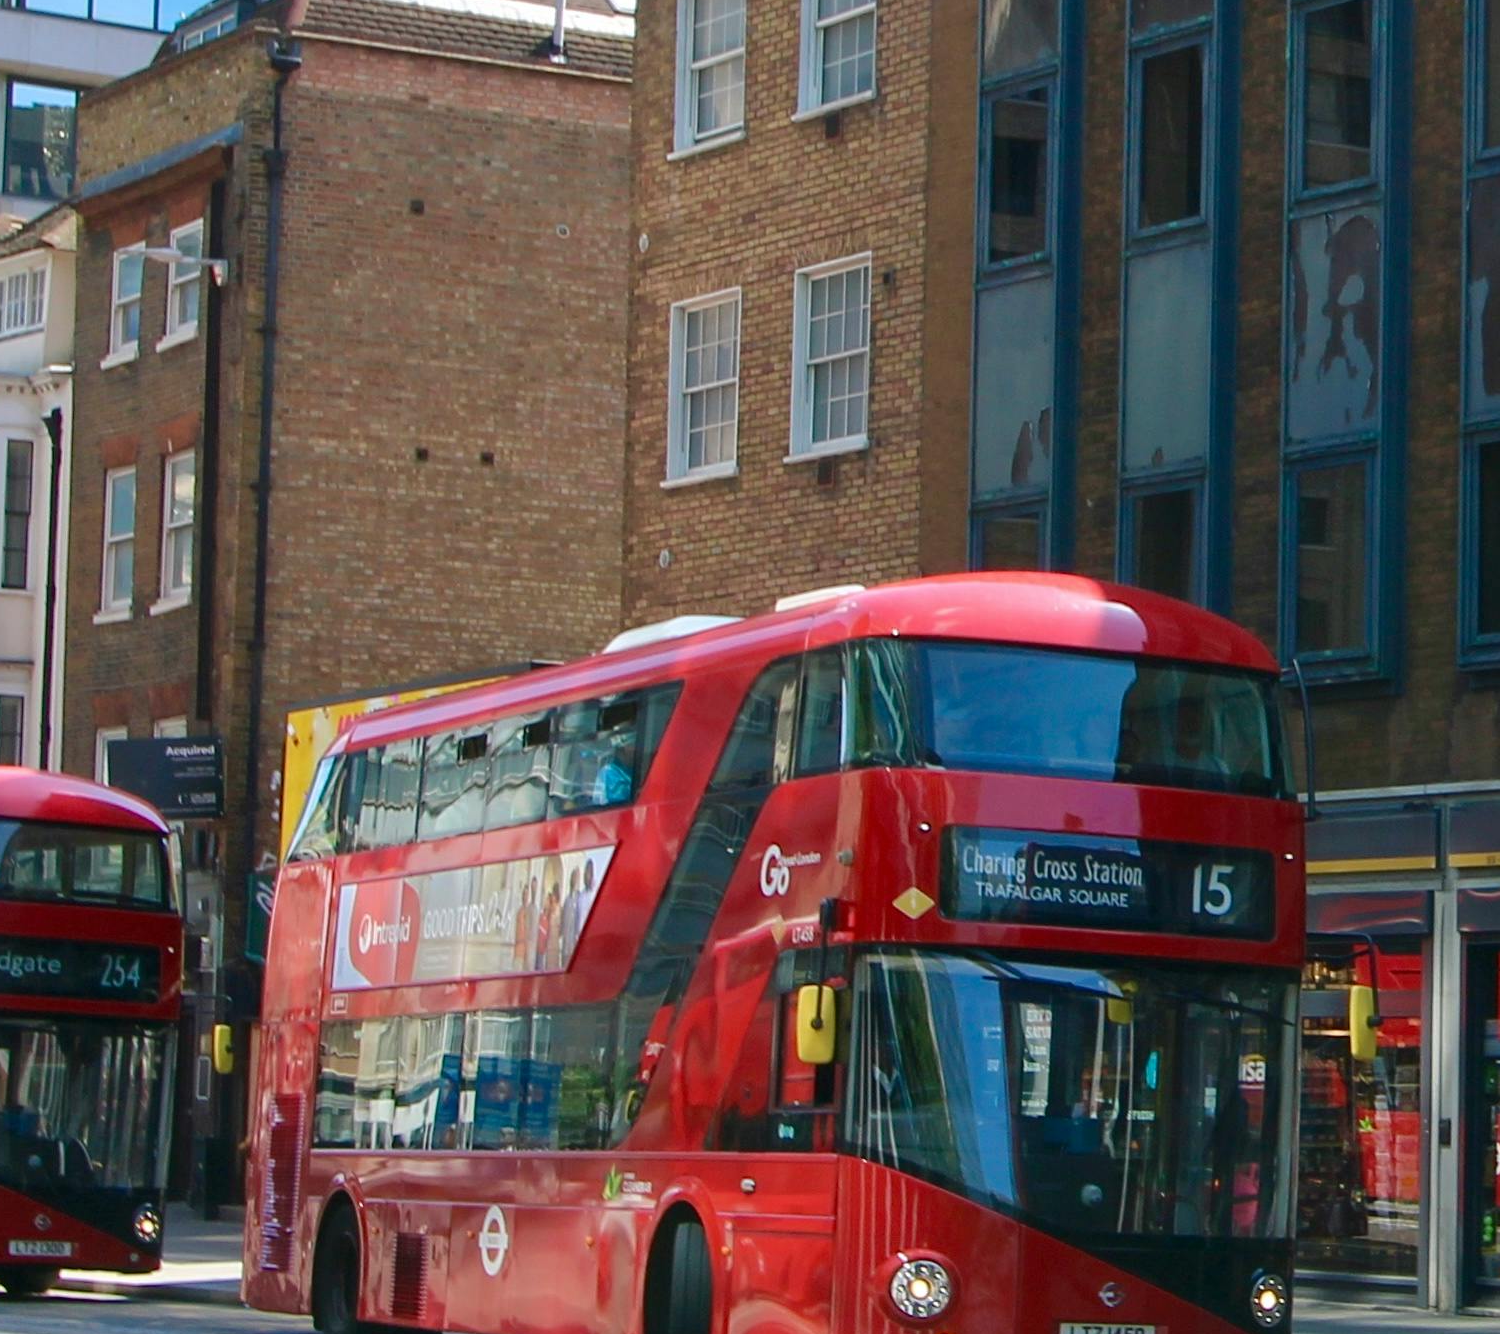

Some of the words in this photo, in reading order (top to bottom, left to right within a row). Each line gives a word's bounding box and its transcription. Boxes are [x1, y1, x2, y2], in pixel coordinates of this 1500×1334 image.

[165, 745, 215, 757] Acquired
[760, 844, 790, 896] Go
[963, 845, 1027, 883] Charing
[1033, 851, 1078, 882] Cross
[1084, 855, 1143, 887] Station
[975, 881, 1064, 903] TRAFALGAR
[1068, 889, 1129, 908] SQUARE
[1192, 863, 1235, 916] 15
[101, 954, 141, 988] 254
